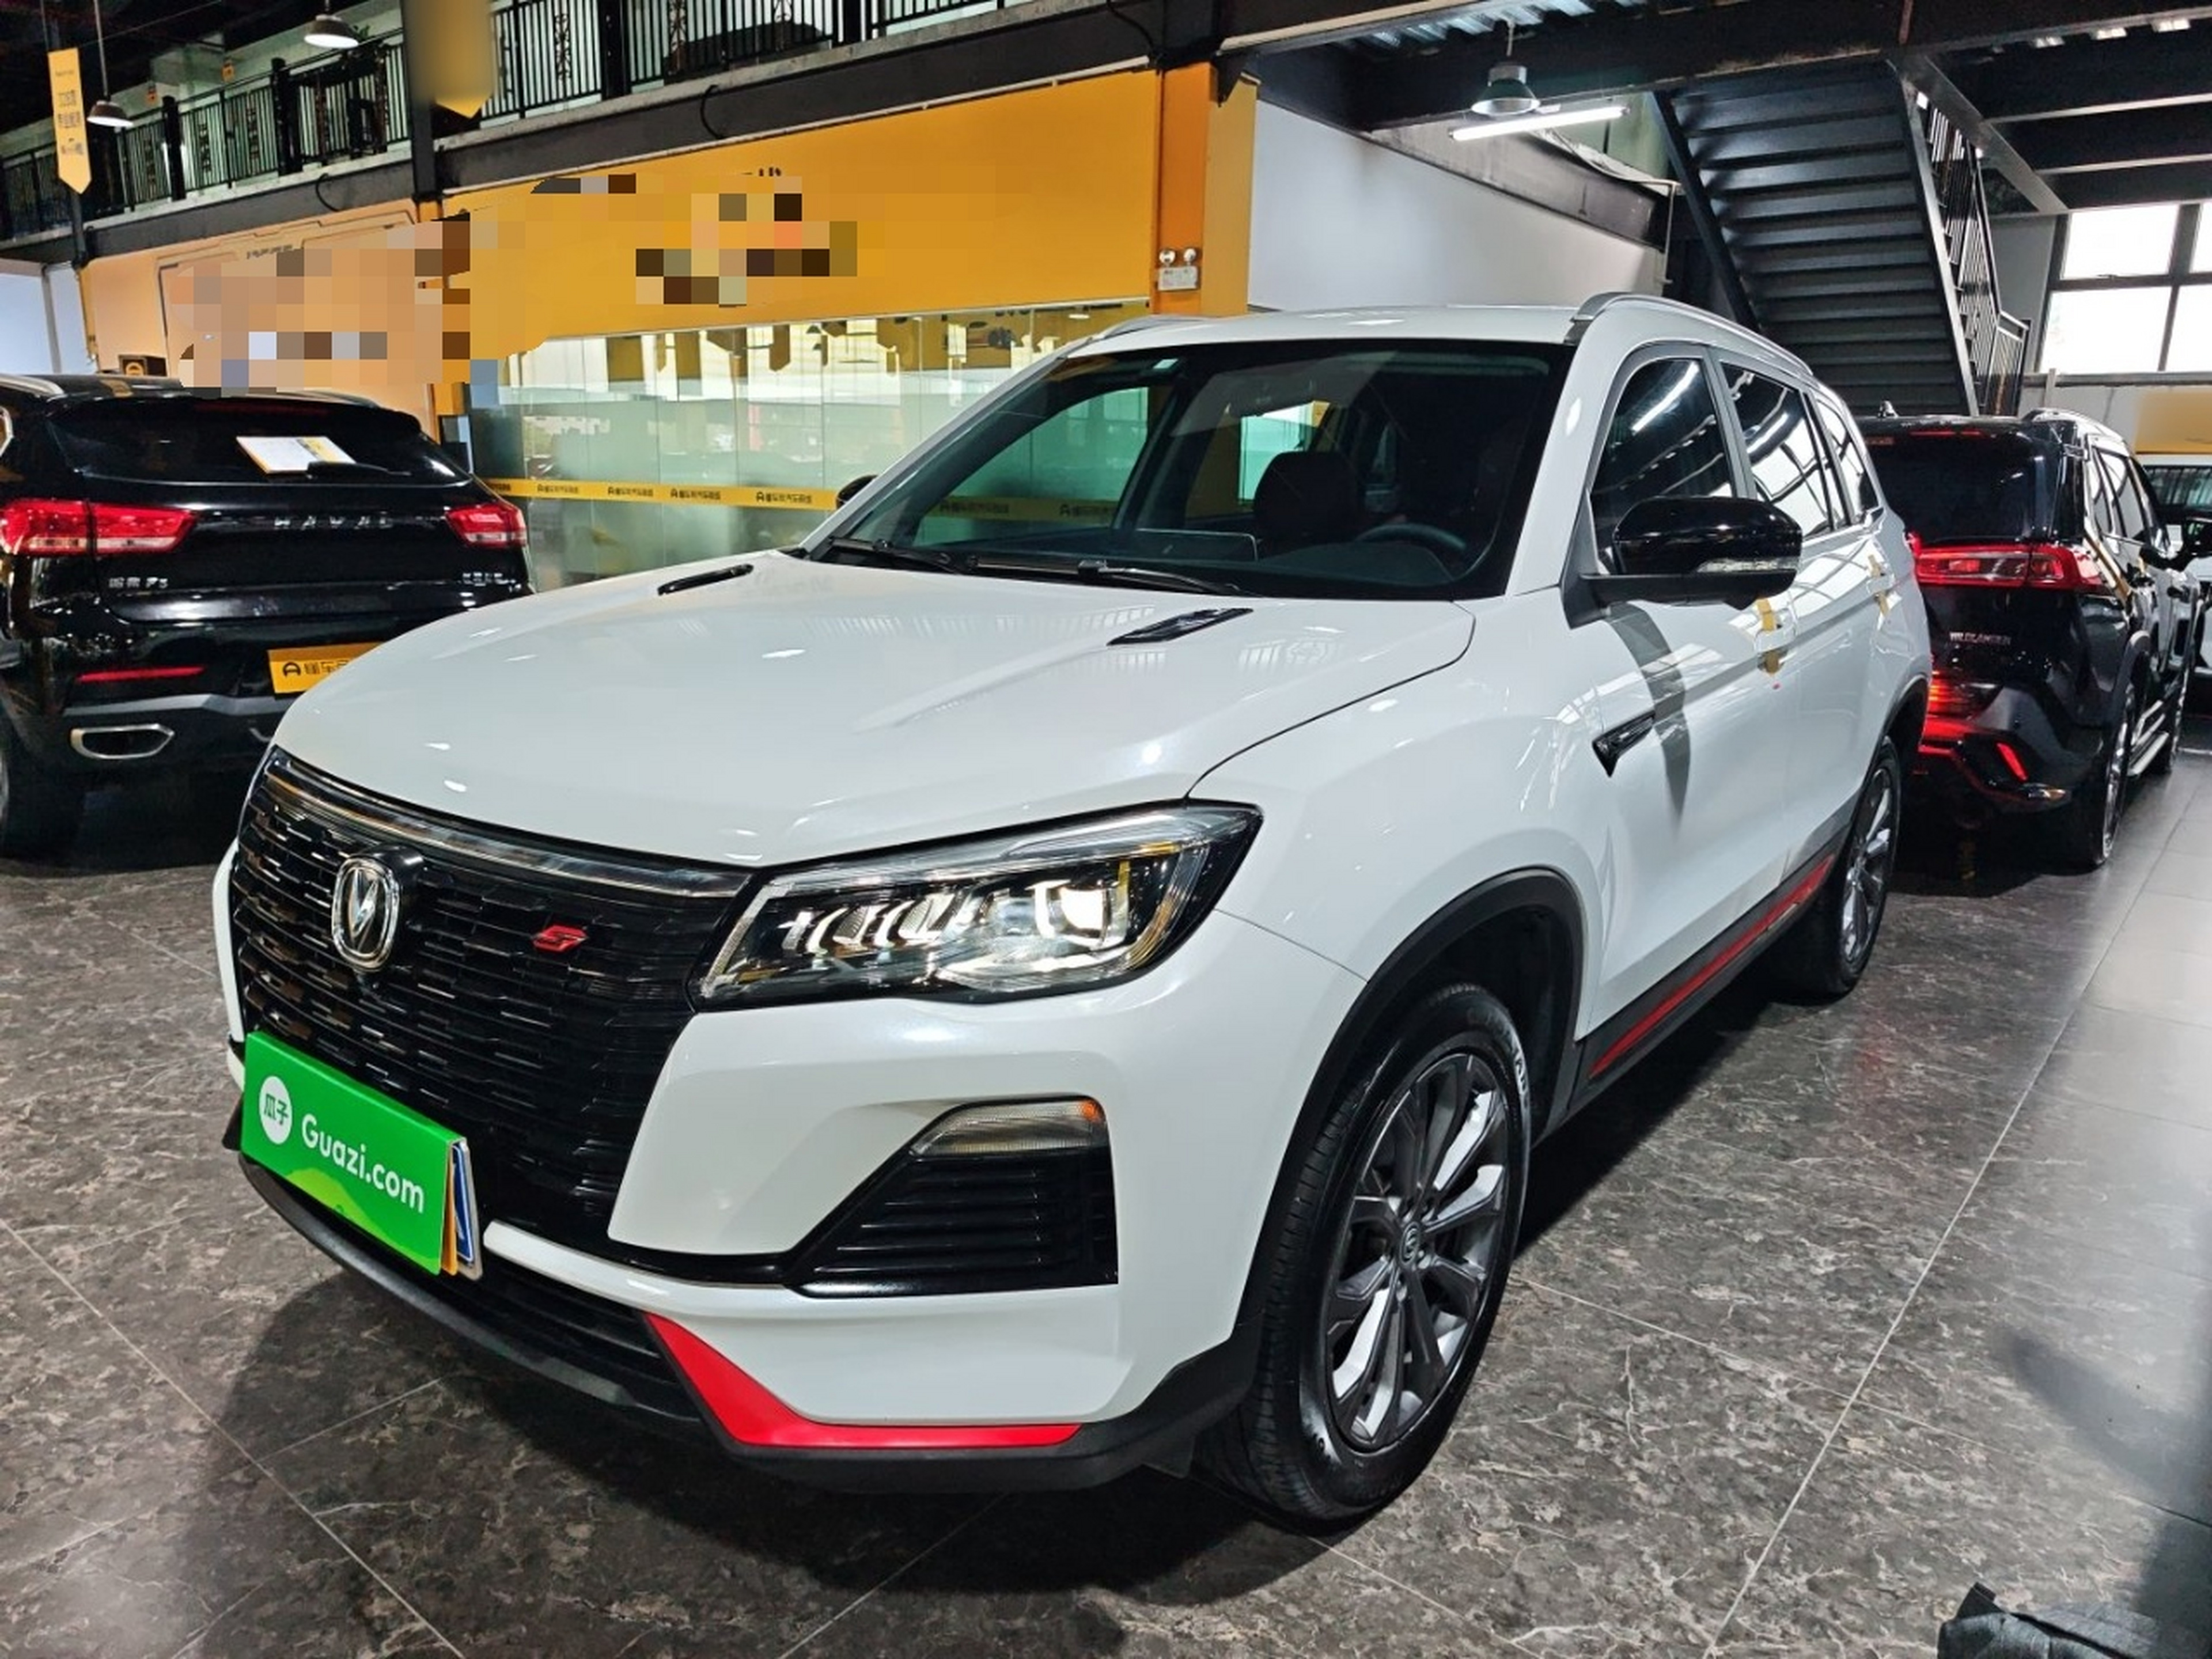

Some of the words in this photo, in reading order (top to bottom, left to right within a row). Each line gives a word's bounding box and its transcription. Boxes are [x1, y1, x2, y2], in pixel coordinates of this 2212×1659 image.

[274, 514, 393, 530] HAVAL
[264, 1093, 289, 1126] 瓜子
[302, 1113, 425, 1214] Guazi.com
